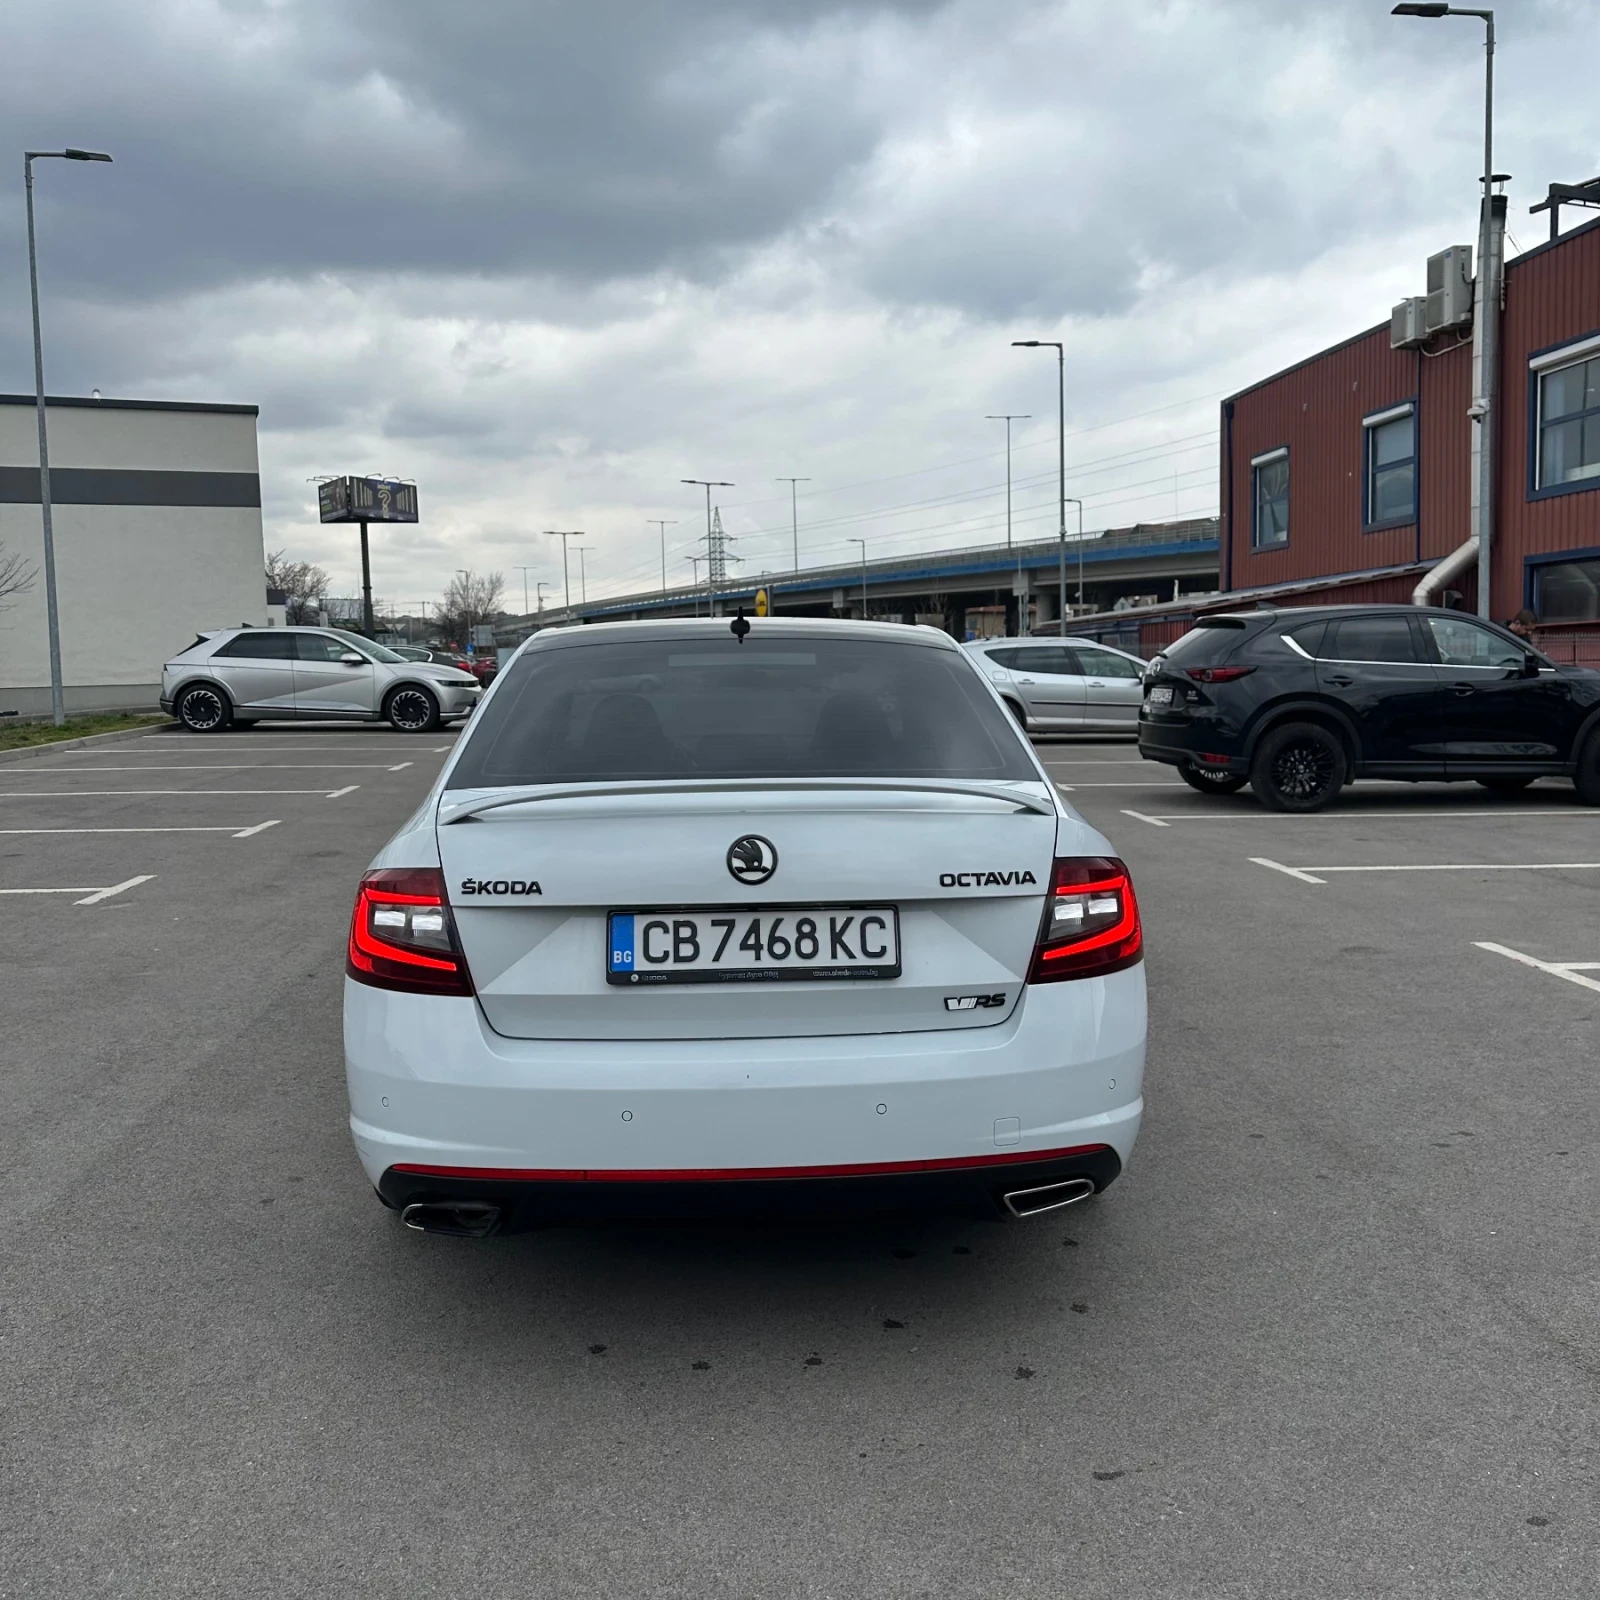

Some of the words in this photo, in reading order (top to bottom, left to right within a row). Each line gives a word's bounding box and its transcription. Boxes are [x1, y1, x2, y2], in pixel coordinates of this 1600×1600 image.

[461, 877, 543, 896] ŠKODA
[939, 870, 1037, 888] OCTAVIA
[643, 919, 700, 964] CB
[710, 917, 819, 962] 7468
[829, 916, 887, 960] KC
[613, 950, 632, 963] BG
